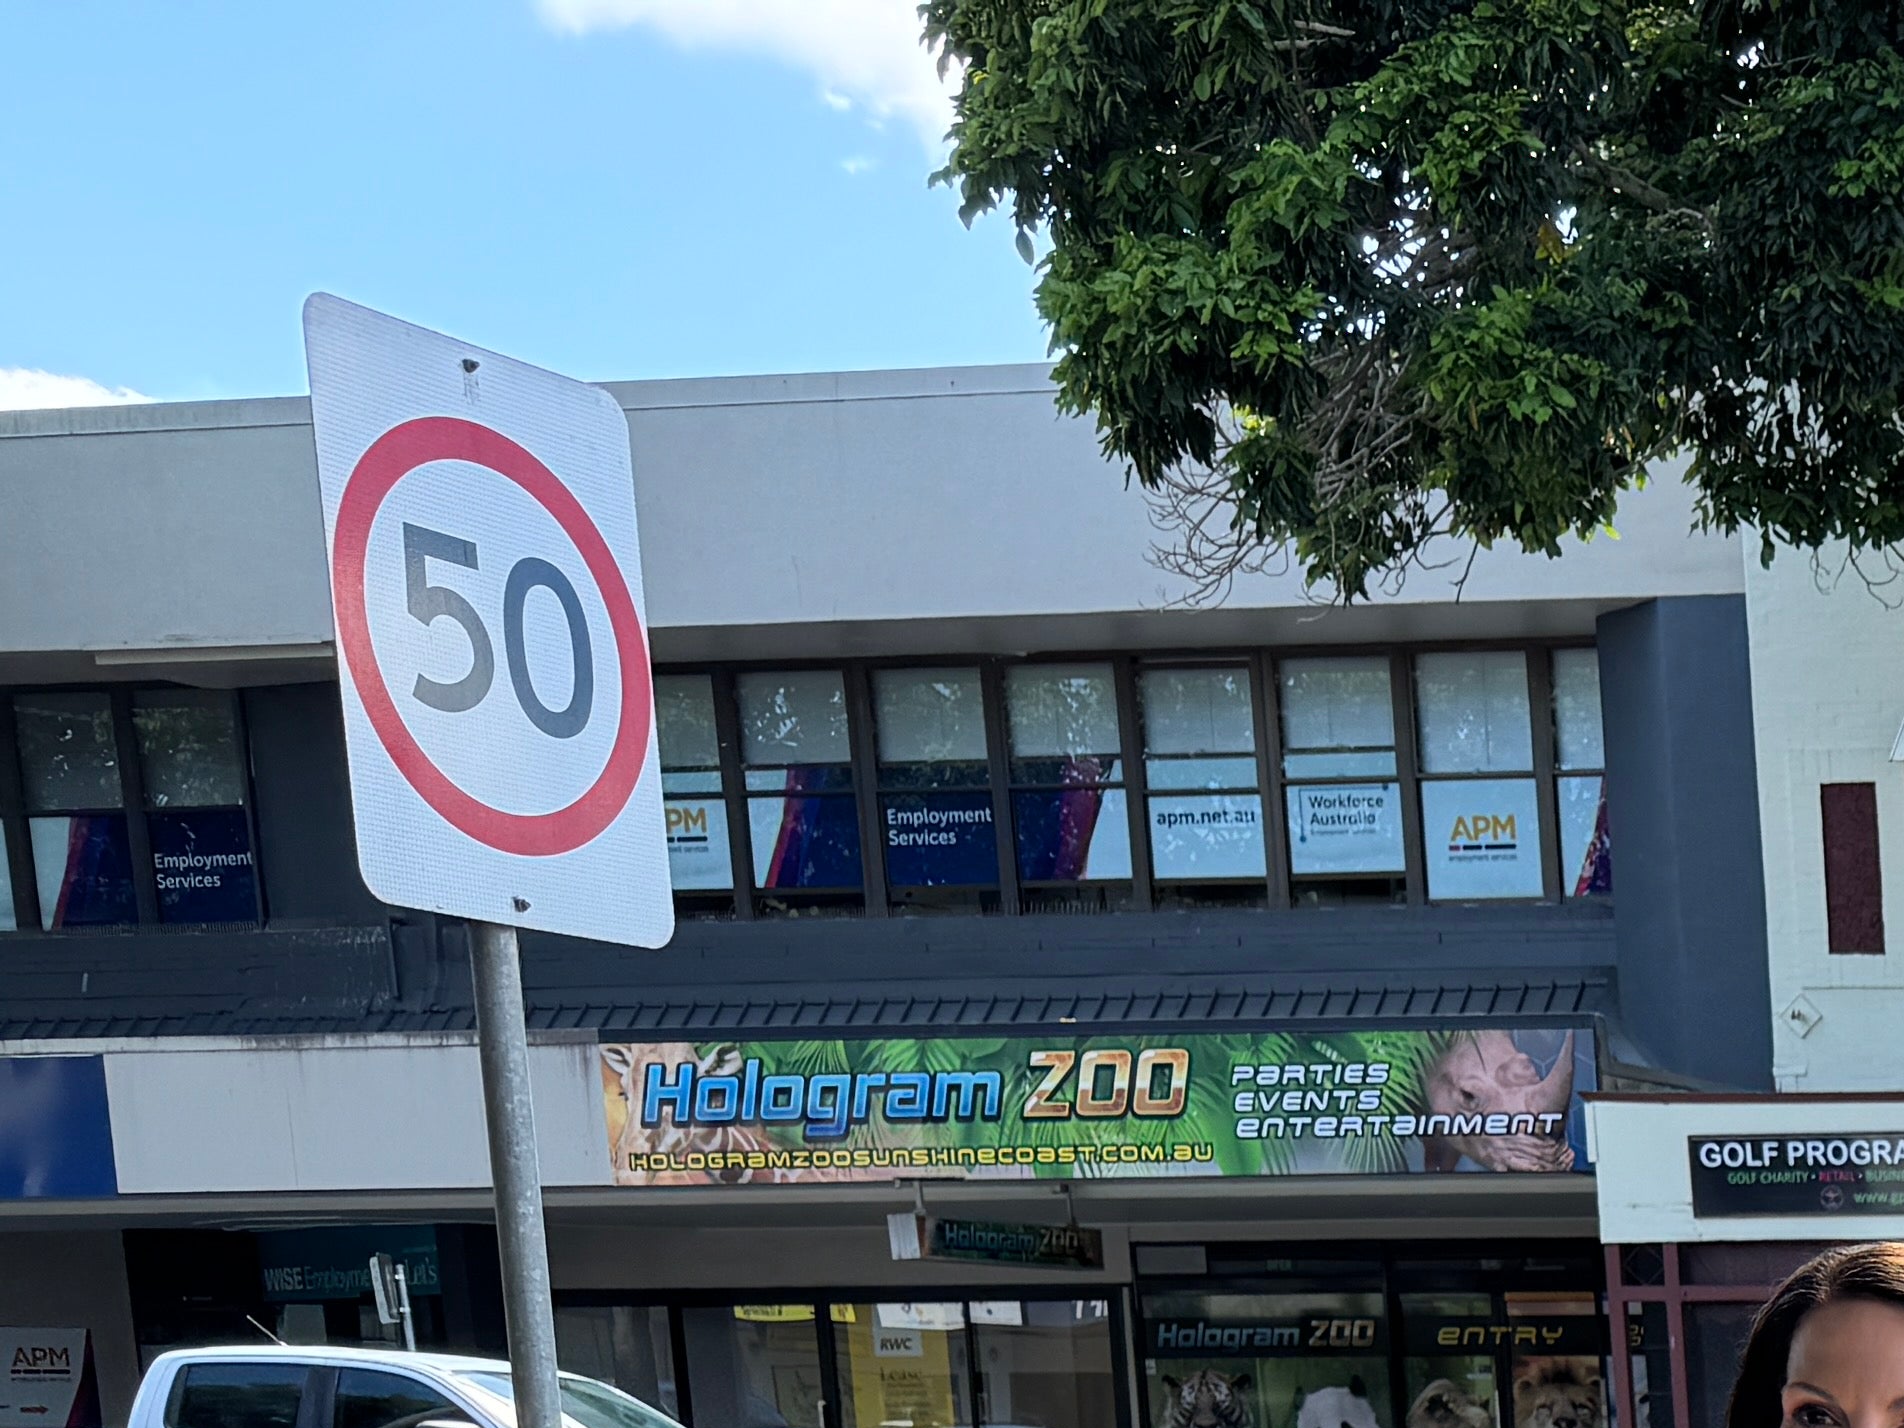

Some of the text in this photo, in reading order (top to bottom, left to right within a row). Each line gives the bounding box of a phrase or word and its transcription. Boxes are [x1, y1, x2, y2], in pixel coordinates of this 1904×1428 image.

[402, 522, 594, 739] 50
[1308, 794, 1384, 809] Workforce
[666, 807, 707, 833] PM
[887, 807, 992, 827] Employment
[1157, 809, 1256, 829] apm.net.au
[1310, 811, 1376, 826] Australia
[1451, 814, 1516, 841] APM
[888, 829, 956, 846] Services
[154, 851, 253, 871] Employment
[156, 874, 221, 889] Services
[1232, 1062, 1391, 1086] PARTIES
[642, 1046, 1190, 1138] Hologram ZOO
[1233, 1089, 1382, 1112] EVENTS
[1236, 1113, 1562, 1139] ENTERTAINMENT
[1700, 1141, 1779, 1168] GOLF
[945, 1222, 1080, 1257] Hologram ZOO
[265, 1266, 303, 1292] WISE
[304, 1265, 371, 1292] Employme
[879, 1338, 913, 1352] RWC
[1158, 1319, 1375, 1352] Hologram ZOO
[1437, 1326, 1563, 1346] ENTRY
[11, 1346, 71, 1368] APM
